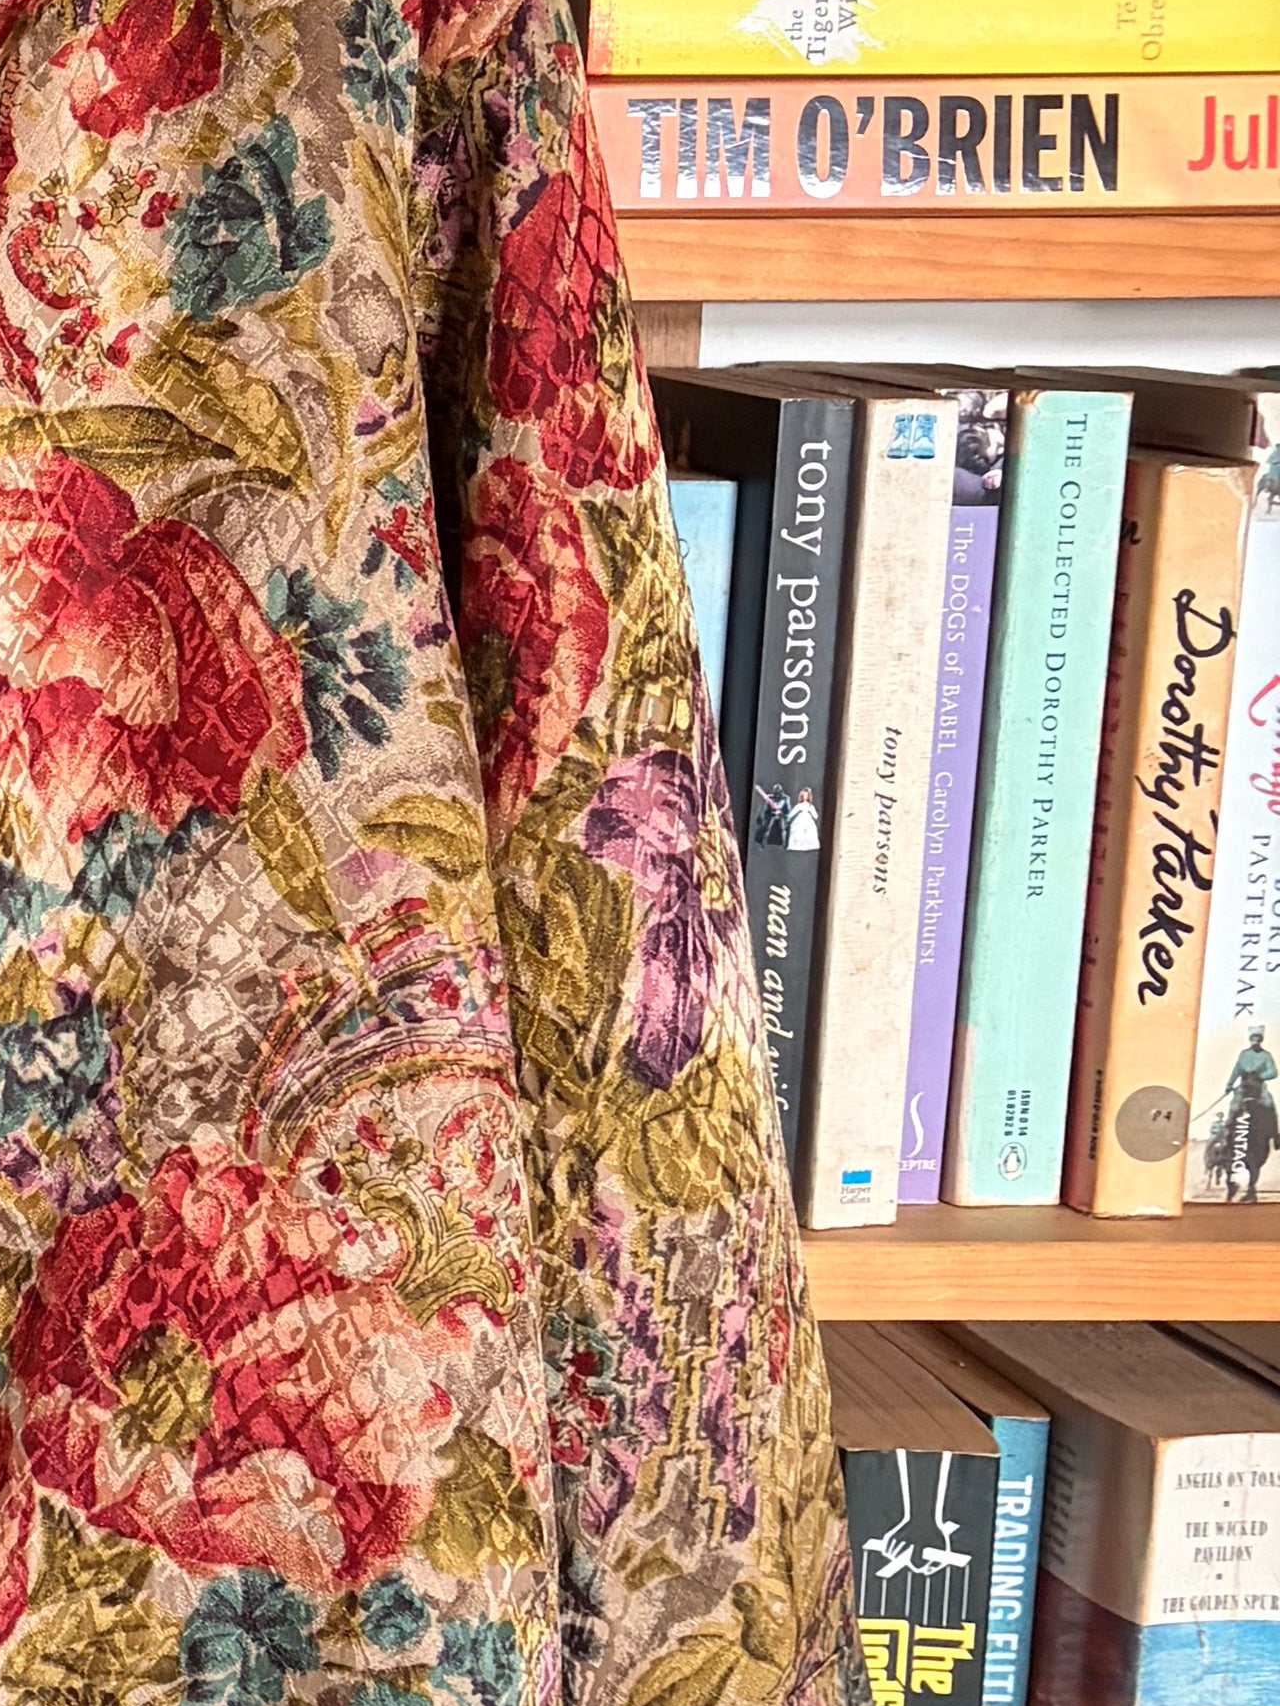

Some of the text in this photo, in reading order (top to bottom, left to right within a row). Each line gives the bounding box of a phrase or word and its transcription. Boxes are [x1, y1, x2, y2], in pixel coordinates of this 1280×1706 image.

[626, 93, 1121, 199] TIM O'BRIEN
[776, 438, 834, 766] tony parsons
[1027, 413, 1091, 903] THE COLLECTED DOROTHY PARKER
